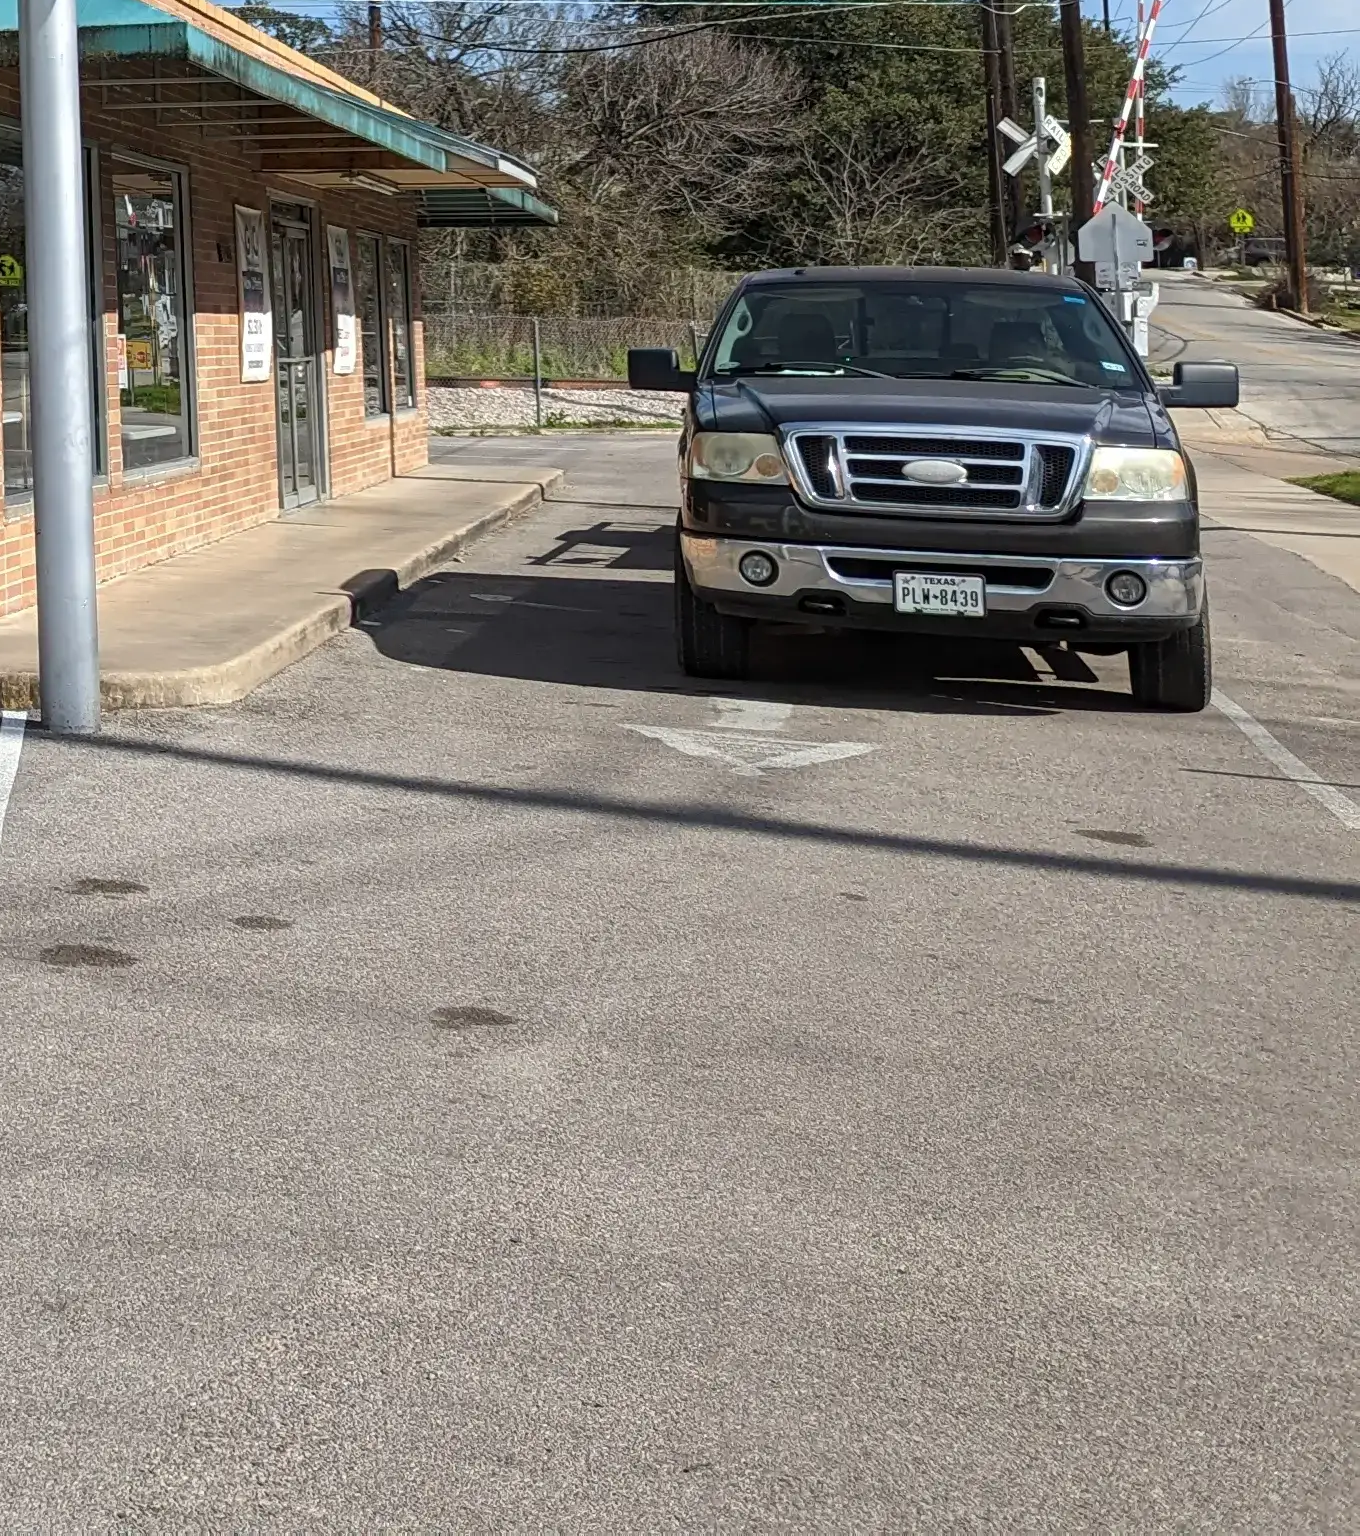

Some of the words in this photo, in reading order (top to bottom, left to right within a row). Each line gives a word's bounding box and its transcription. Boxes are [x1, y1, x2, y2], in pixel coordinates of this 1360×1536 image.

[1045, 118, 1064, 143] RAIL
[1100, 157, 1151, 201] RILROAD
[922, 577, 956, 586] TEXAS
